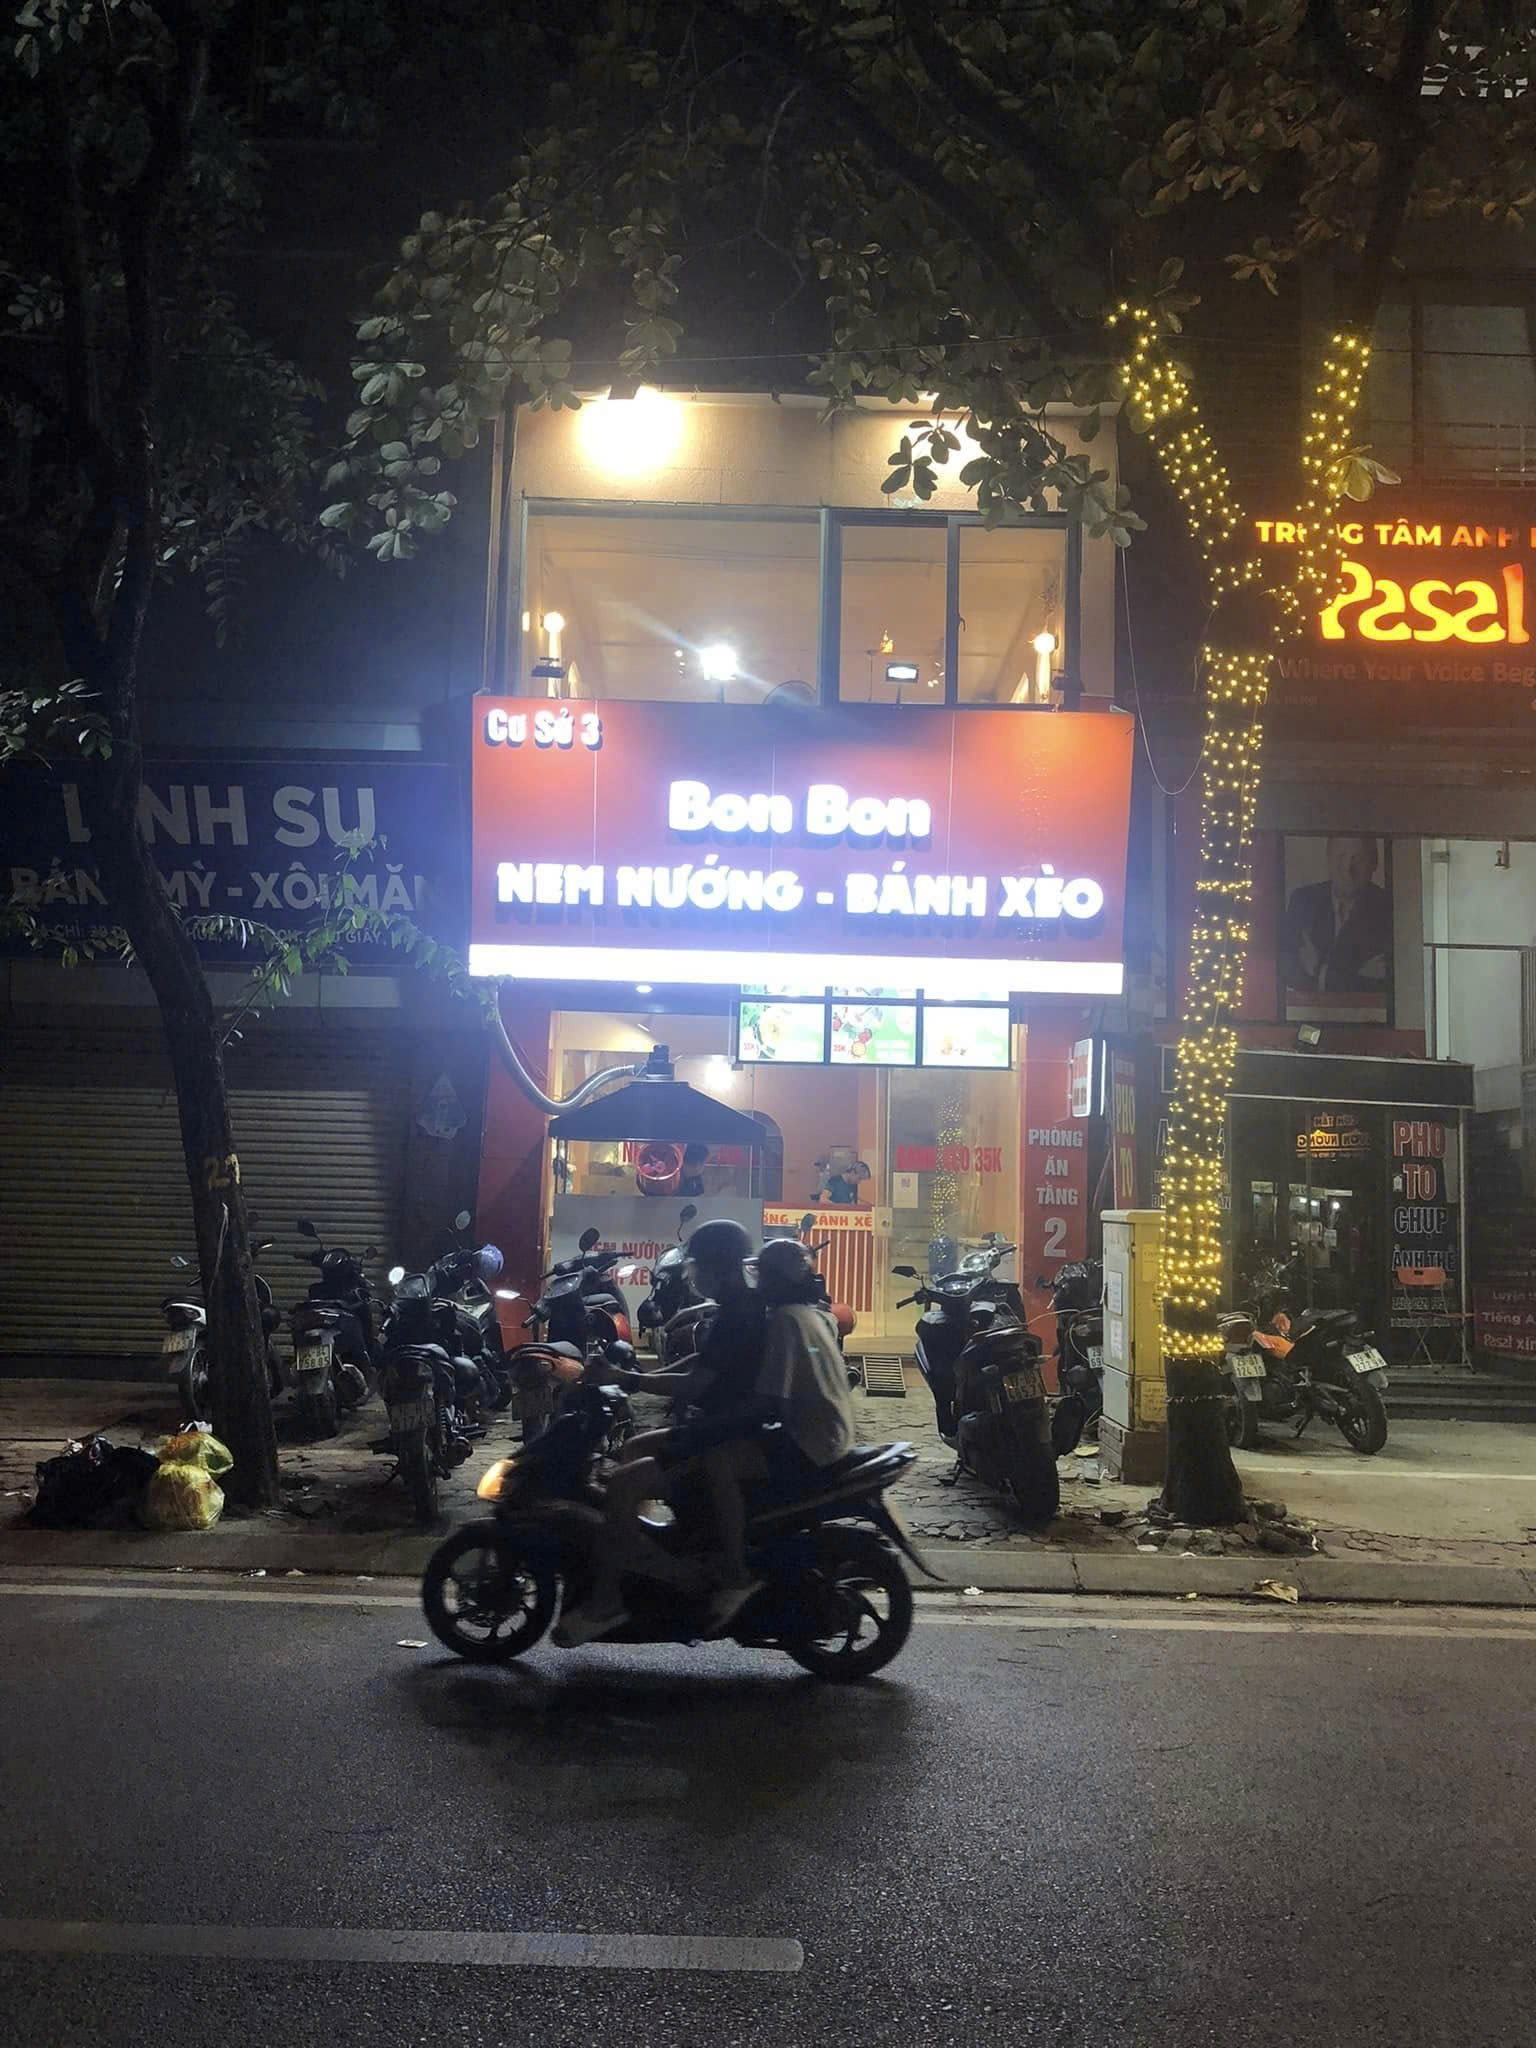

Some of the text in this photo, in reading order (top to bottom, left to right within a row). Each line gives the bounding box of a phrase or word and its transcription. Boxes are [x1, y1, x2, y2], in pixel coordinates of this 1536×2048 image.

[1255, 521, 1363, 545] TRG
[1374, 518, 1441, 545] TÂM
[1278, 658, 1355, 680] Where
[1365, 660, 1413, 681] Your
[1424, 662, 1485, 682] Voice
[488, 706, 600, 746] Cơ Sở 3
[62, 784, 248, 847] LNH
[668, 781, 930, 837] Bon Bon
[250, 862, 329, 910] XÔI
[497, 862, 604, 905] NEM
[617, 855, 803, 912] NƯỚNG
[847, 861, 986, 917] BÁNH
[999, 864, 1104, 919] XÈO
[1029, 1127, 1083, 1148] PHÒNG
[1392, 1120, 1446, 1158] PHO
[1402, 1163, 1437, 1200] TO
[1043, 1217, 1067, 1258] 2
[1394, 1206, 1448, 1238] CHỤP
